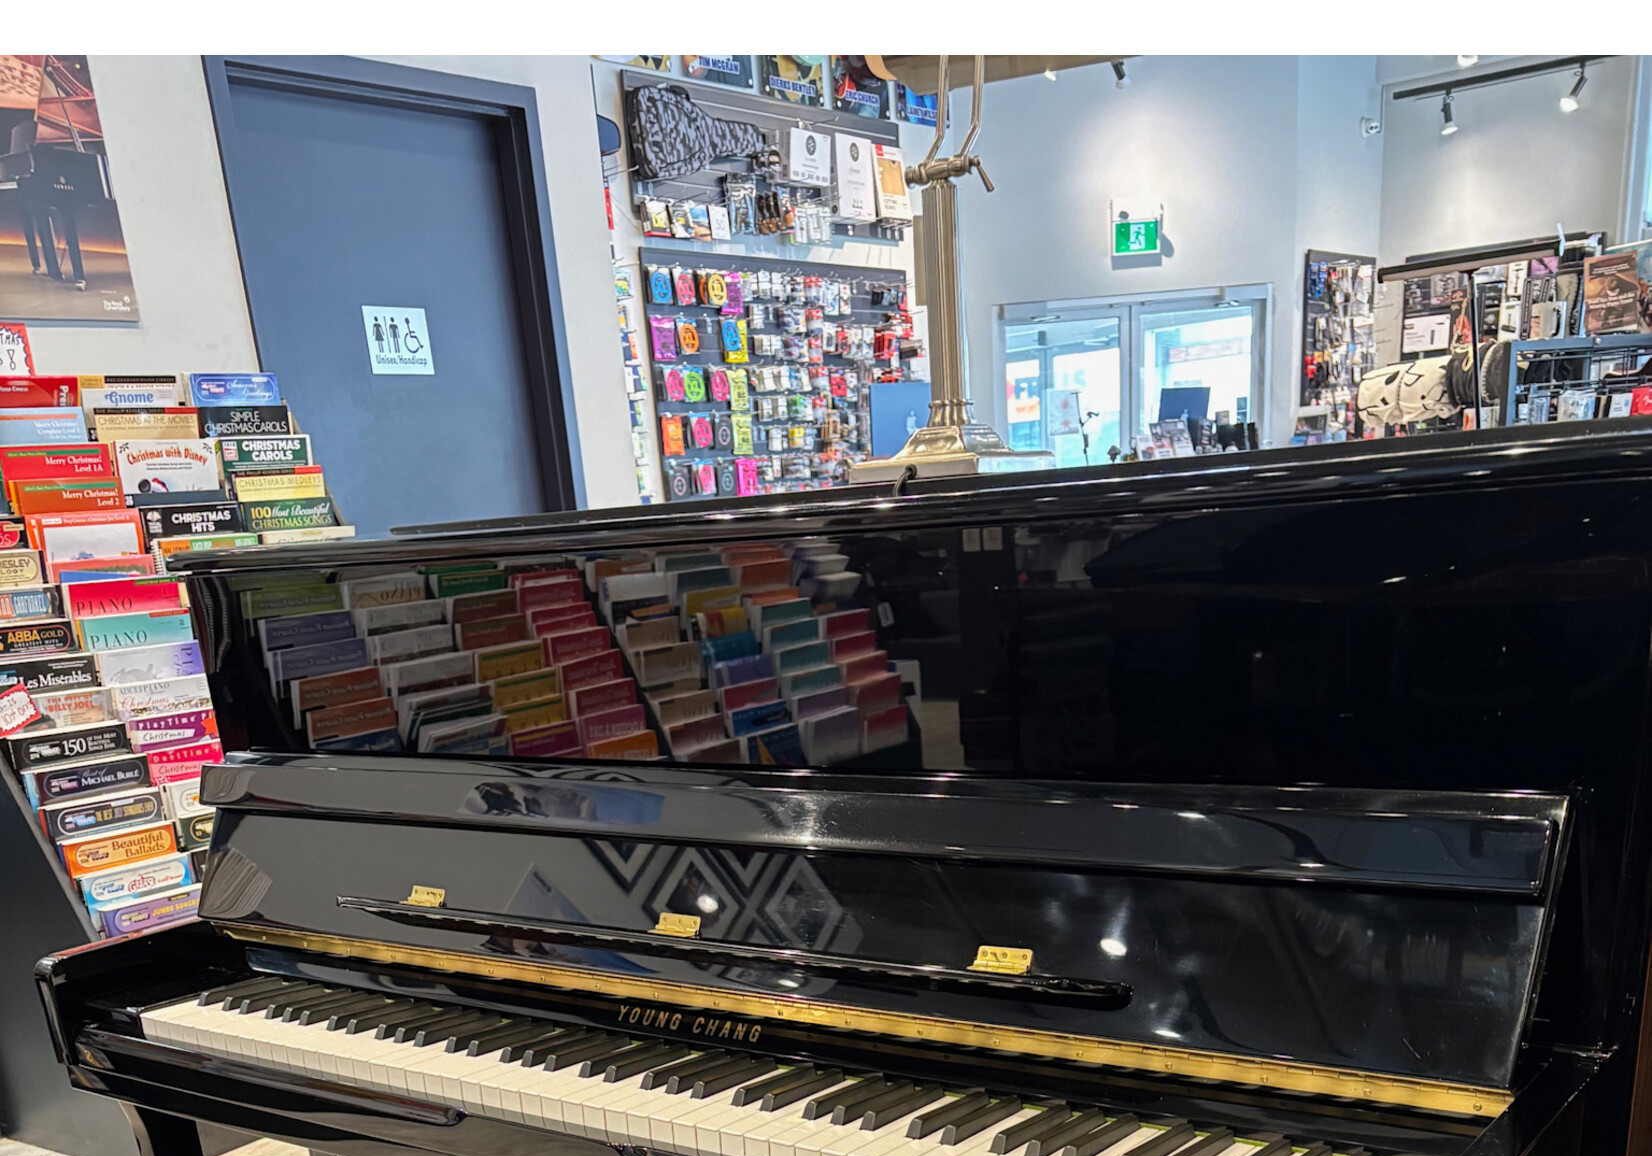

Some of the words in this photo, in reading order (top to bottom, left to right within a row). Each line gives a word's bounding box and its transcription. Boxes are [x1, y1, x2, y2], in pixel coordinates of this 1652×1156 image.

[398, 355, 427, 367] Handicap
[105, 391, 154, 407] Gnome
[98, 416, 142, 426] CHRISTMAS
[230, 411, 260, 422] SIMPLE
[205, 423, 253, 434] CHRISTMAS
[253, 421, 288, 432] CAROLS
[241, 440, 301, 452] CHRISTMAS
[45, 457, 66, 466] Merry
[67, 455, 103, 465] Christmas!
[126, 450, 163, 466] Christmas
[165, 447, 182, 458] with
[183, 447, 208, 466] Disney
[252, 450, 294, 461] CAROLS
[75, 465, 92, 473] Level
[239, 478, 286, 488] CHRISTMAS
[62, 492, 83, 501] Merry
[84, 489, 119, 498] Christmas!
[97, 498, 115, 507] Level
[171, 511, 231, 524] CHRISTMAS
[250, 507, 272, 519] 100
[291, 503, 331, 516] Beautiful
[192, 522, 216, 533] HITS
[252, 517, 302, 530] CHRISTMAS
[304, 514, 333, 526] SONGS
[76, 597, 133, 616] PIANO
[7, 629, 40, 644] ABBA
[40, 630, 65, 640] GOLD
[90, 629, 148, 650] PIANO
[48, 702, 72, 712] BILLY
[73, 699, 94, 710] JOEL
[143, 731, 186, 742] Christmas
[62, 738, 87, 756] 150
[112, 831, 163, 851] Beautiful
[125, 841, 166, 859] Ballads
[618, 1004, 683, 1031] YOUNG
[692, 1015, 762, 1044] CHANG
